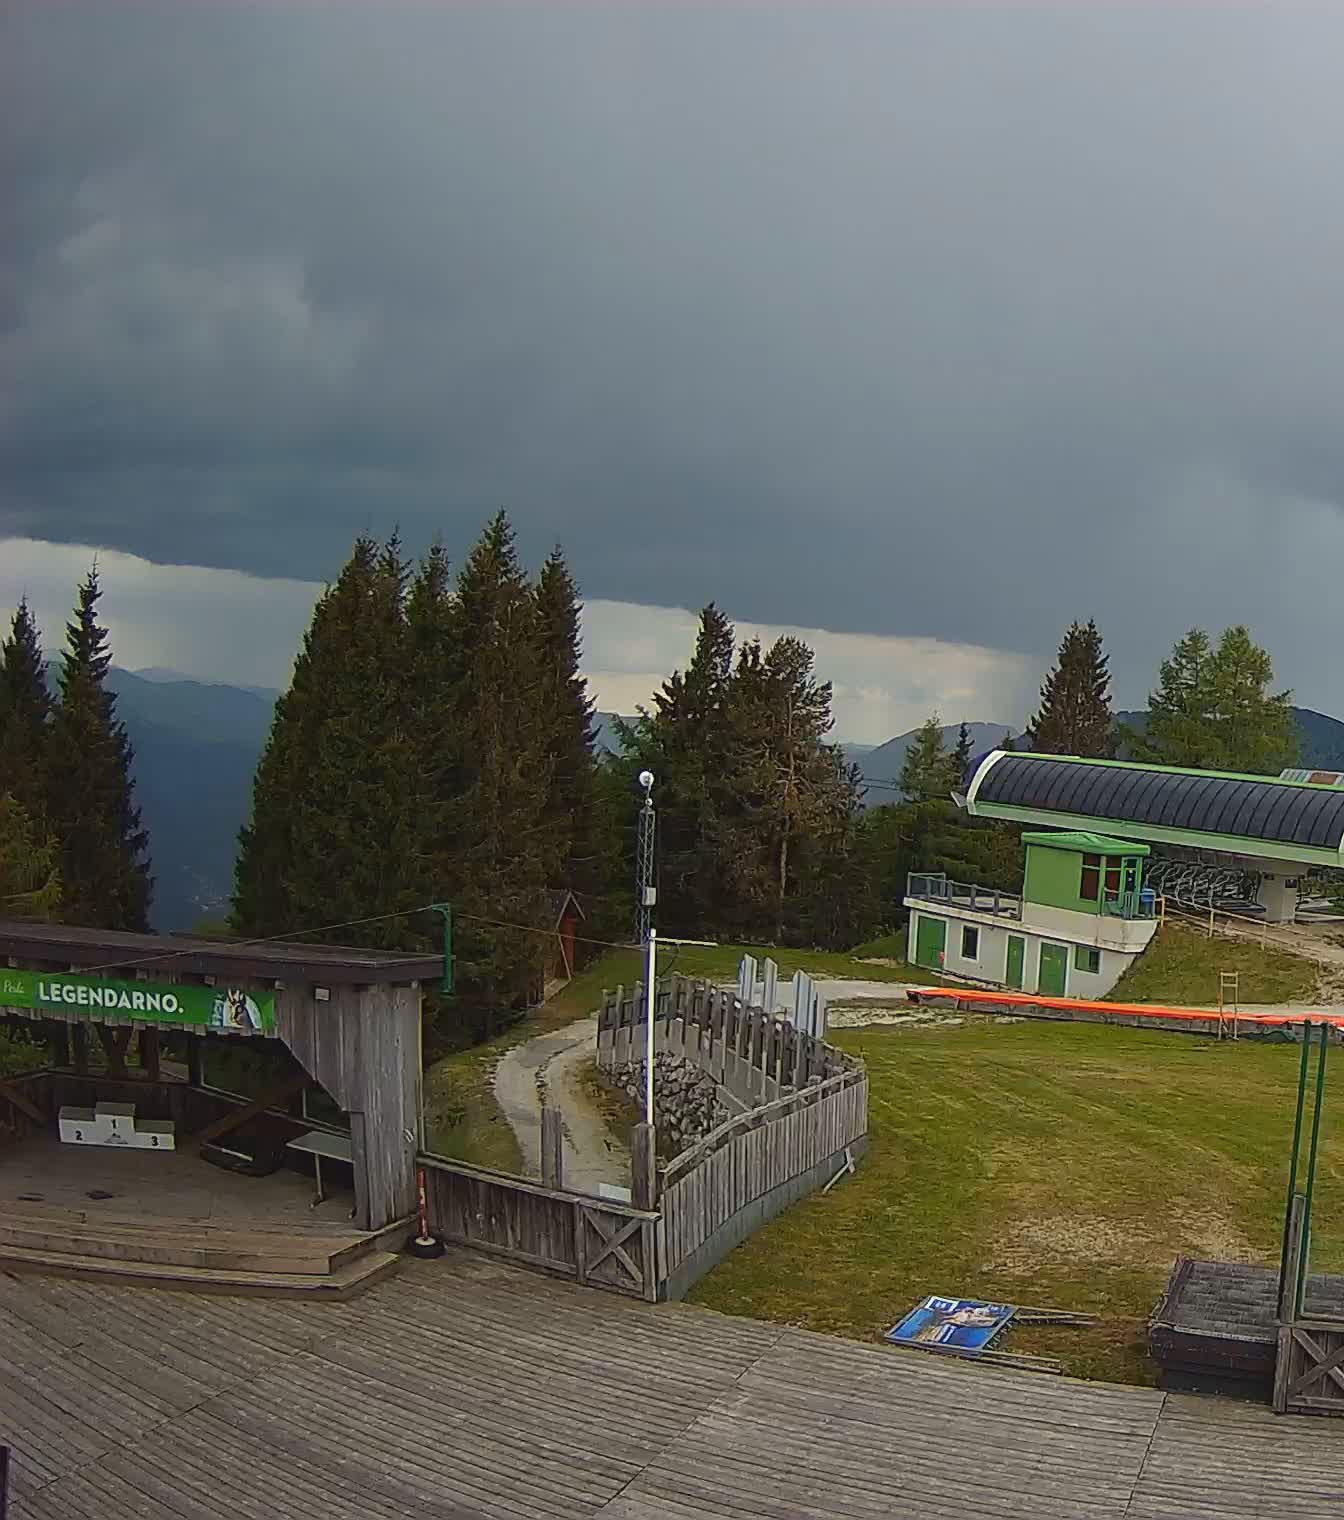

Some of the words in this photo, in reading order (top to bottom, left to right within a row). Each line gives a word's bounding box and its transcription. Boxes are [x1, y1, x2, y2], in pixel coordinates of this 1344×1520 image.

[39, 981, 184, 1014] LEGENDARNO.
[75, 1130, 83, 1141] 2
[151, 1135, 160, 1147] 3
